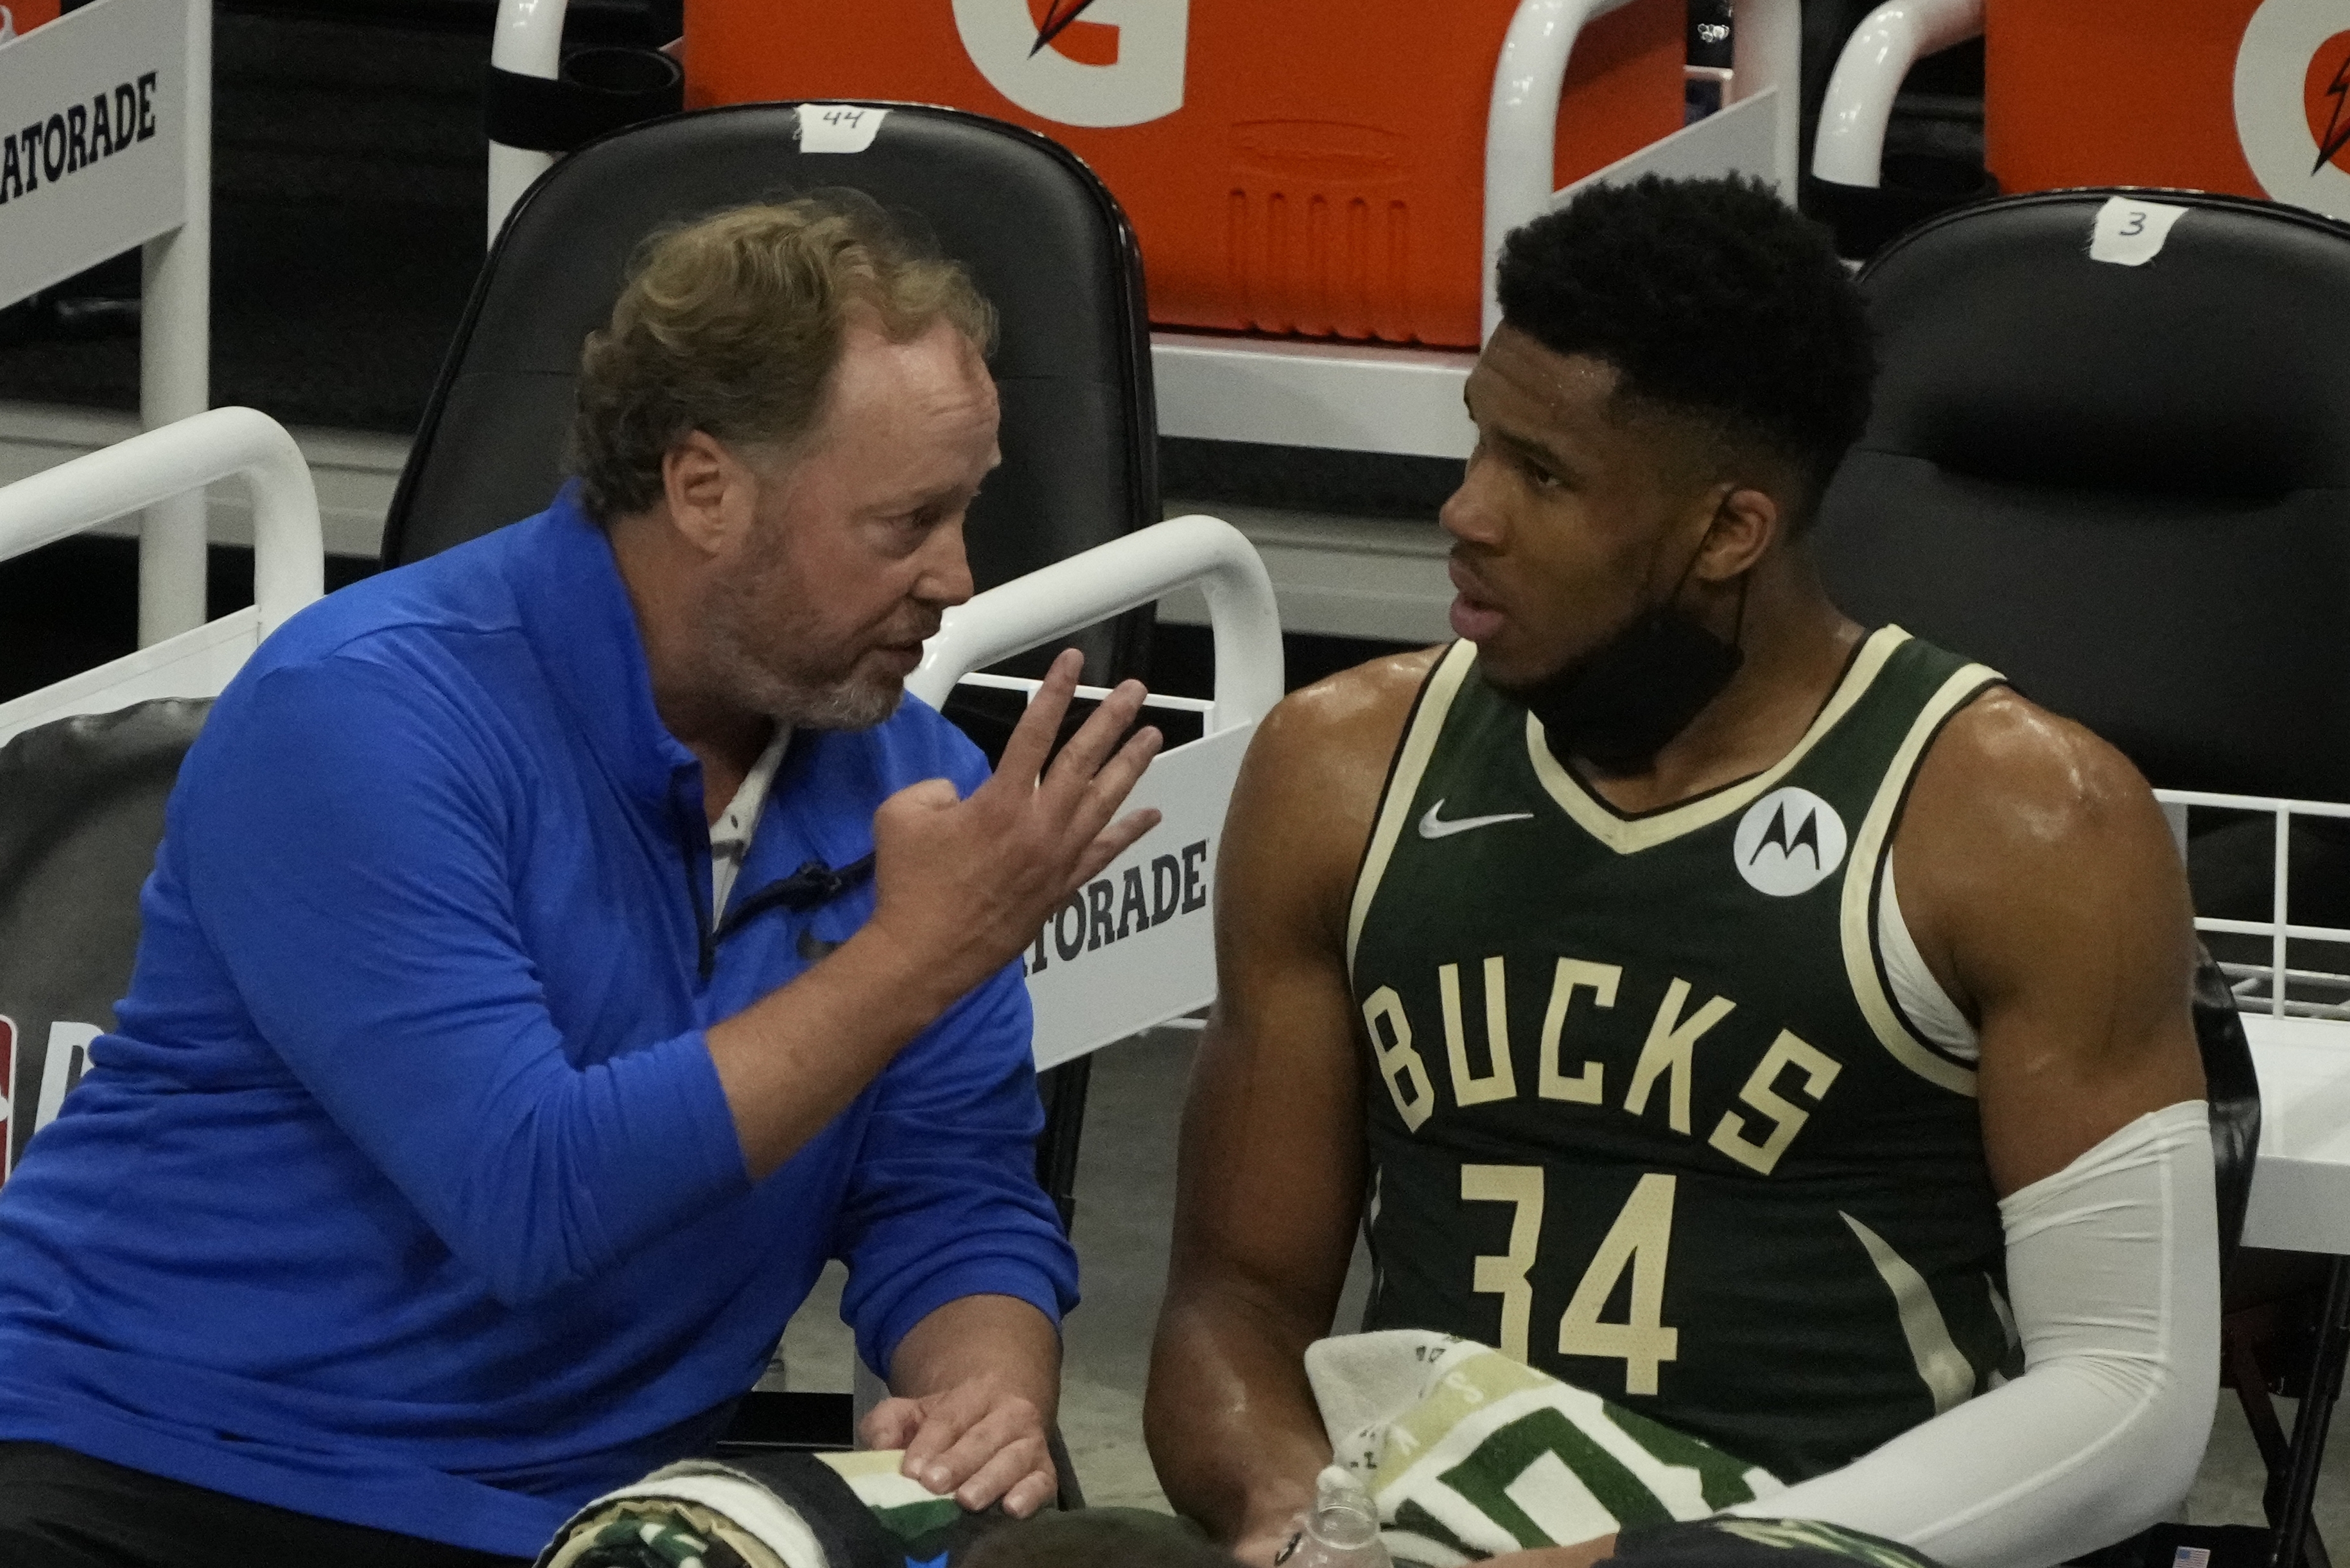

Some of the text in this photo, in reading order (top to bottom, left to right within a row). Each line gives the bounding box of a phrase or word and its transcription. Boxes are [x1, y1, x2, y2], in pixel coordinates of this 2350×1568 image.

[0, 70, 158, 205] ATORADE
[823, 110, 866, 128] 44
[2119, 211, 2146, 236] 3
[1023, 838, 1207, 978] TORADE
[1362, 955, 1843, 1176] BUCKS
[1460, 1163, 1678, 1396] 34
